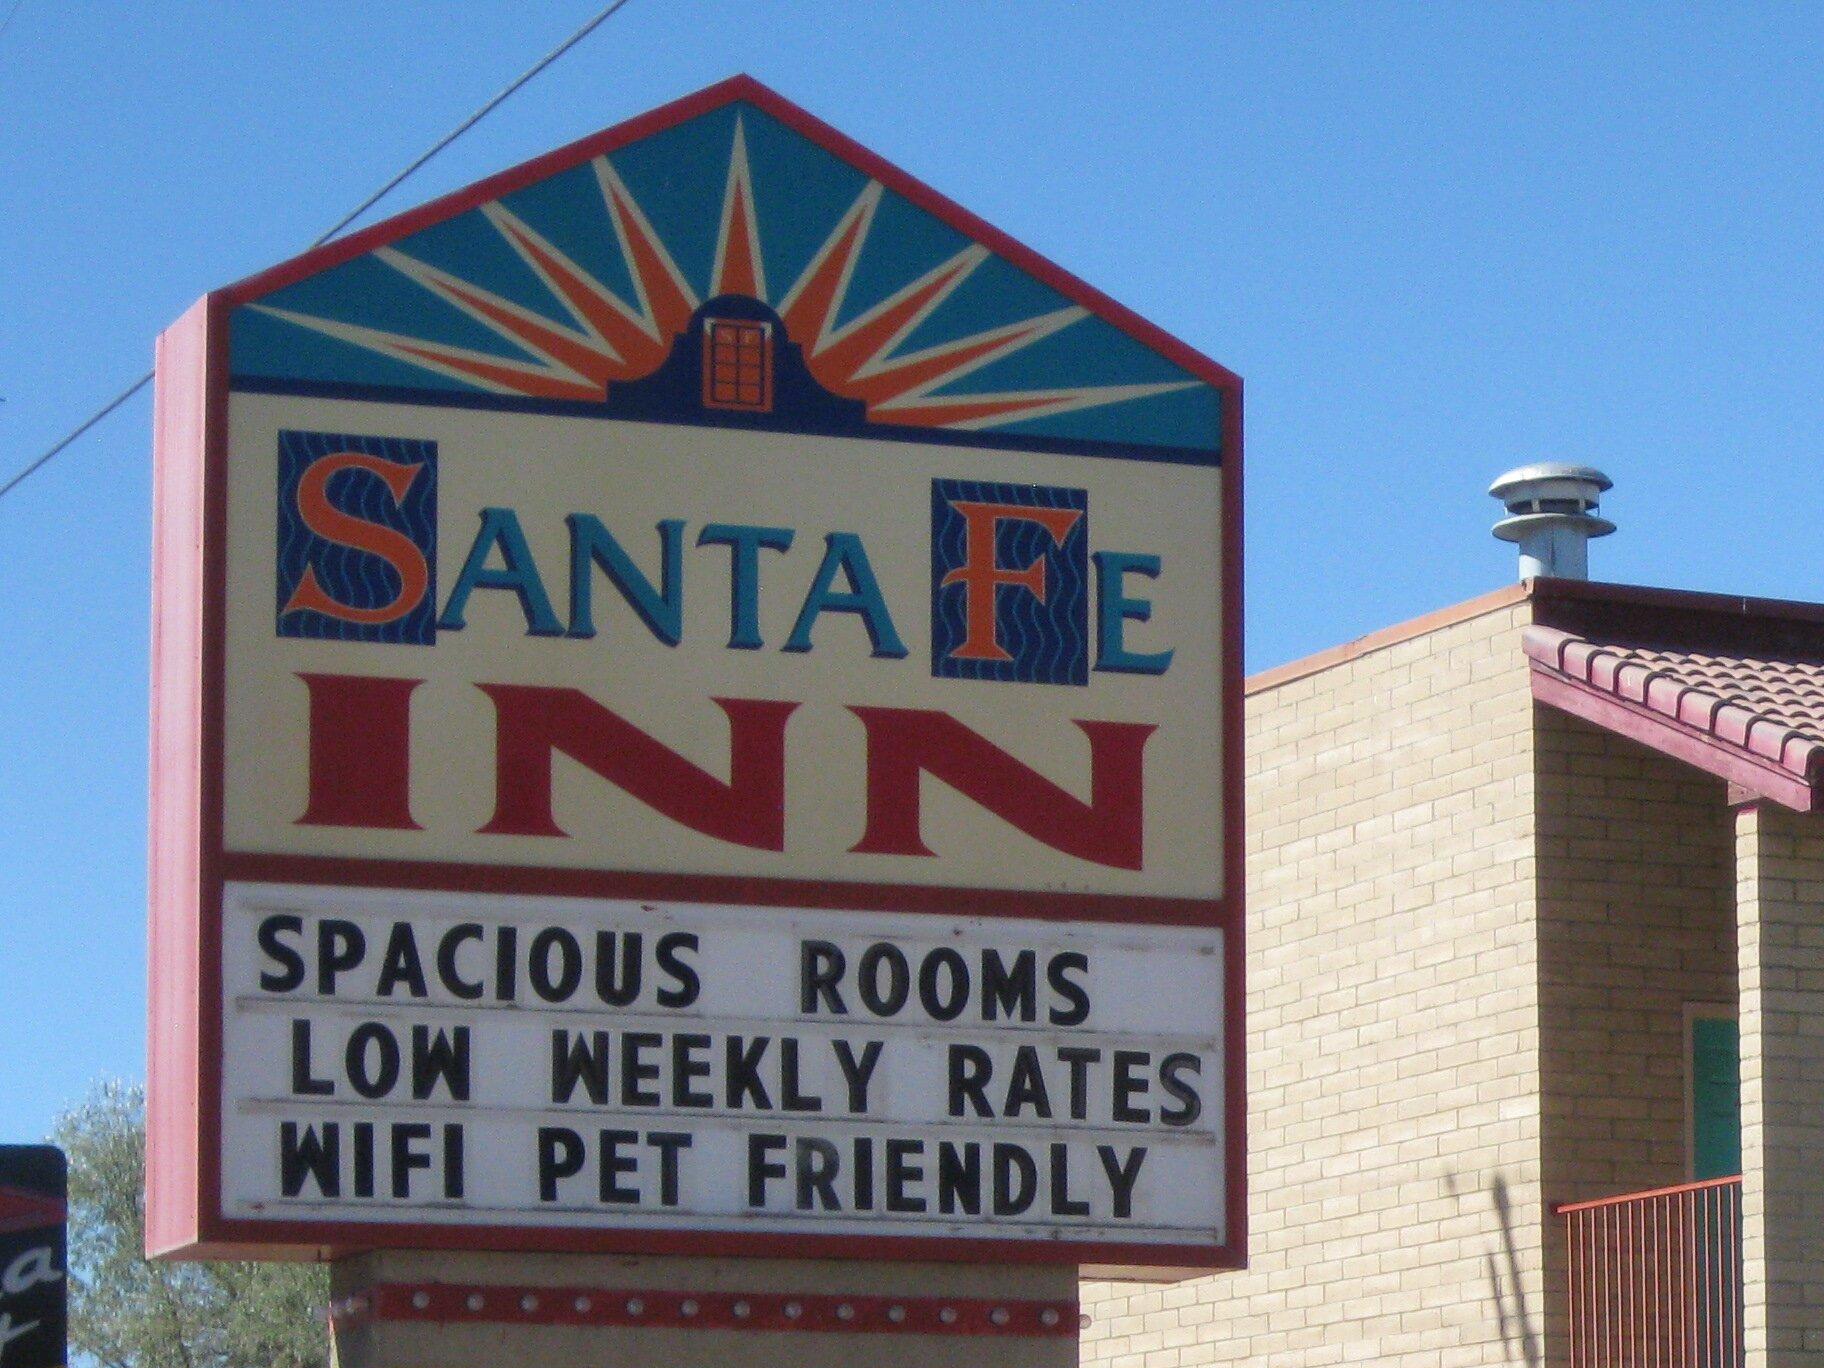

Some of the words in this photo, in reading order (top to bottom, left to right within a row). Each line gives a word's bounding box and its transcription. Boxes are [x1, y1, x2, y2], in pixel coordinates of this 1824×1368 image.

[280, 449, 910, 662] SANTA
[941, 498, 1176, 676] FE
[290, 672, 1161, 872] INN
[256, 915, 702, 1009] SPACIOUS
[802, 939, 1091, 1027] ROOMS
[291, 1019, 471, 1102] LOW
[550, 1029, 884, 1114] WEEKLY
[947, 1044, 1203, 1128] RATES
[279, 1121, 466, 1199] WIFI
[537, 1126, 693, 1206] PET
[747, 1136, 1147, 1220] FRIENDLY
